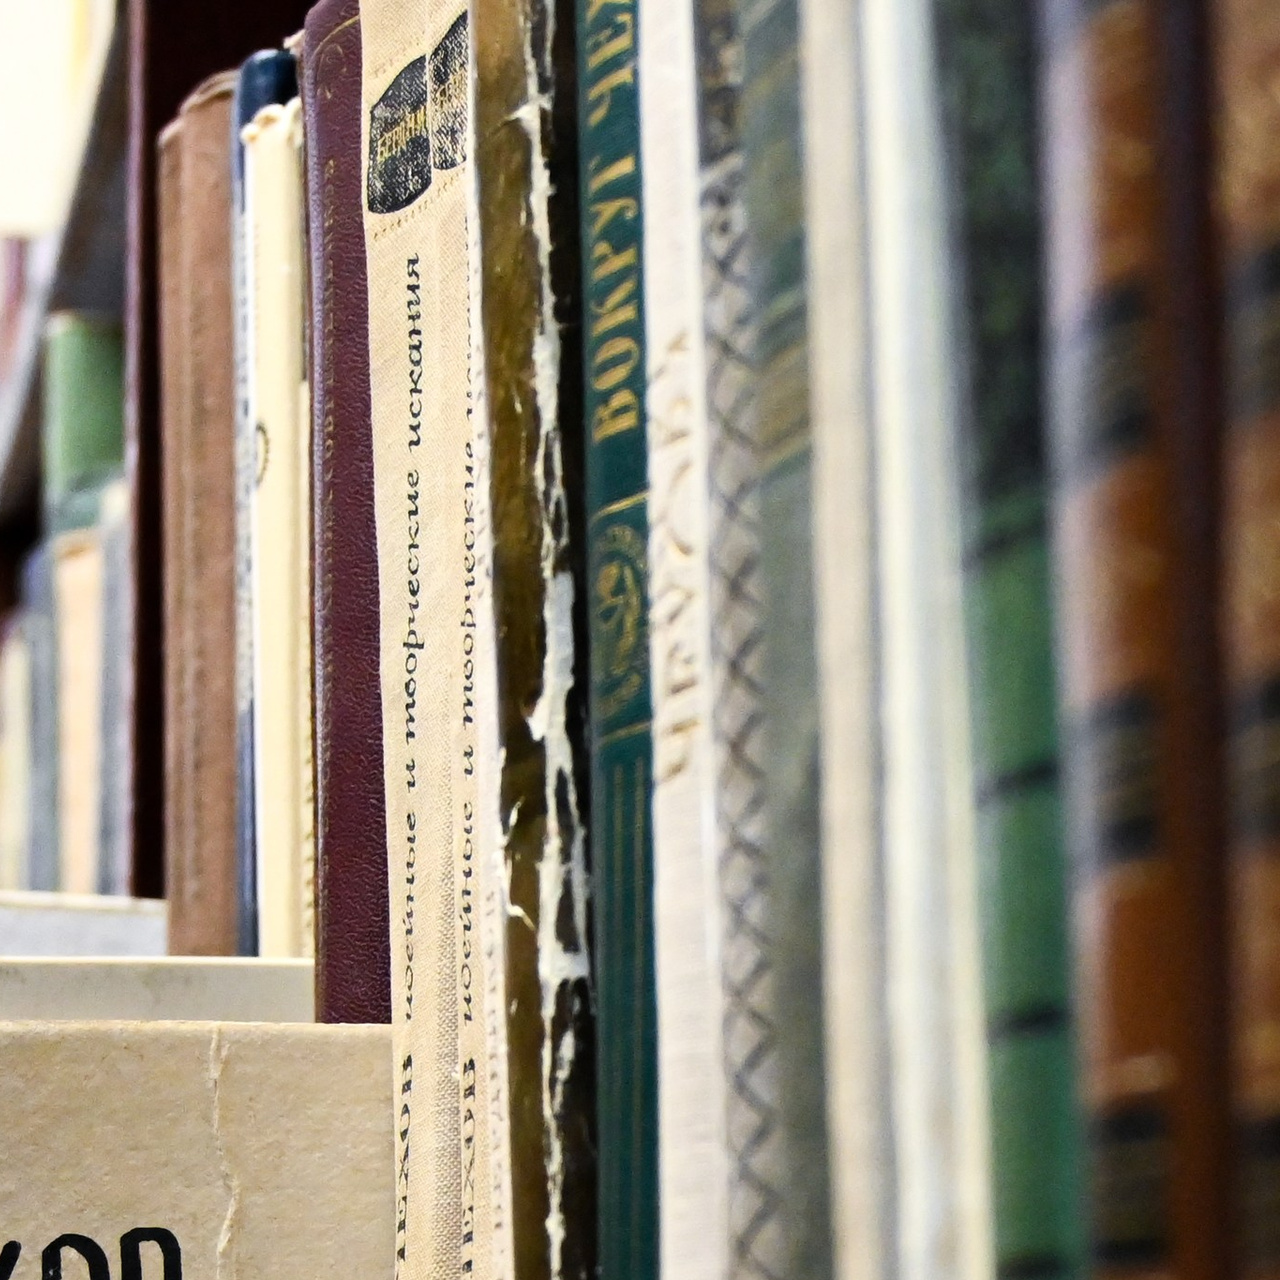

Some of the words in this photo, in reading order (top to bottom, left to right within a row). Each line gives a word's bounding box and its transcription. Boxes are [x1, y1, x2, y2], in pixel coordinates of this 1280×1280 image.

[405, 252, 423, 450] искания
[588, 152, 640, 443] ВОКРУГ
[401, 468, 425, 745] творческие
[461, 441, 477, 729] творческие
[404, 758, 417, 791] и
[402, 812, 417, 1022] идейные
[460, 802, 474, 1025] идейные
